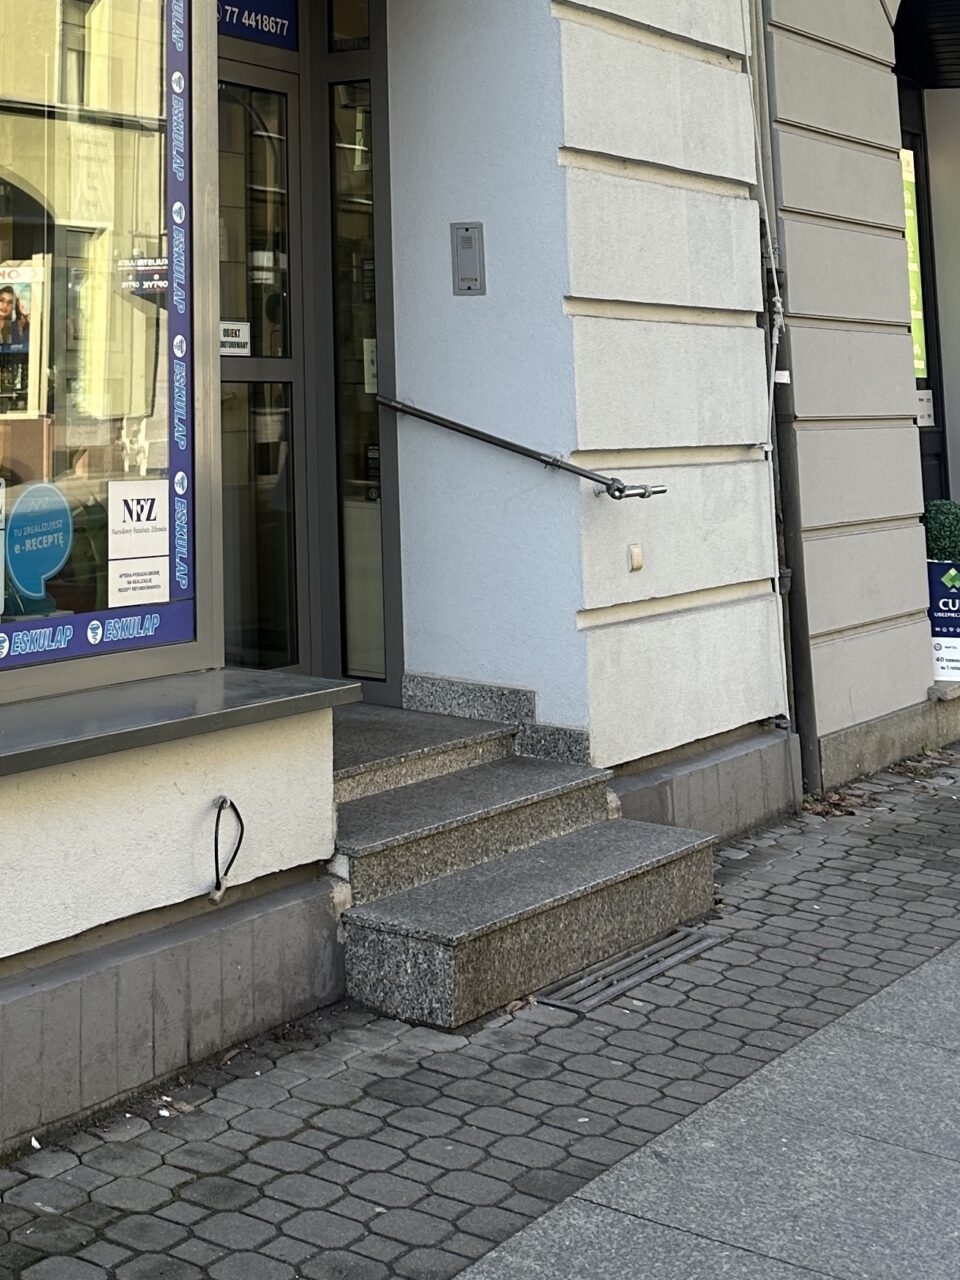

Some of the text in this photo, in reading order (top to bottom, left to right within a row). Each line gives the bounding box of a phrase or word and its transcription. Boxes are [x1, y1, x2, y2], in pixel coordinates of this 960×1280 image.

[224, 5, 289, 36] 77 4418677
[172, 94, 184, 182] ESKULAP
[172, 225, 185, 314] ESKULAP
[173, 360, 186, 450] ESKULAP
[122, 498, 157, 523] NFZ
[175, 497, 188, 590] ESKULAP
[10, 625, 73, 655] ESKULAP
[103, 614, 160, 642] ESKULAP
